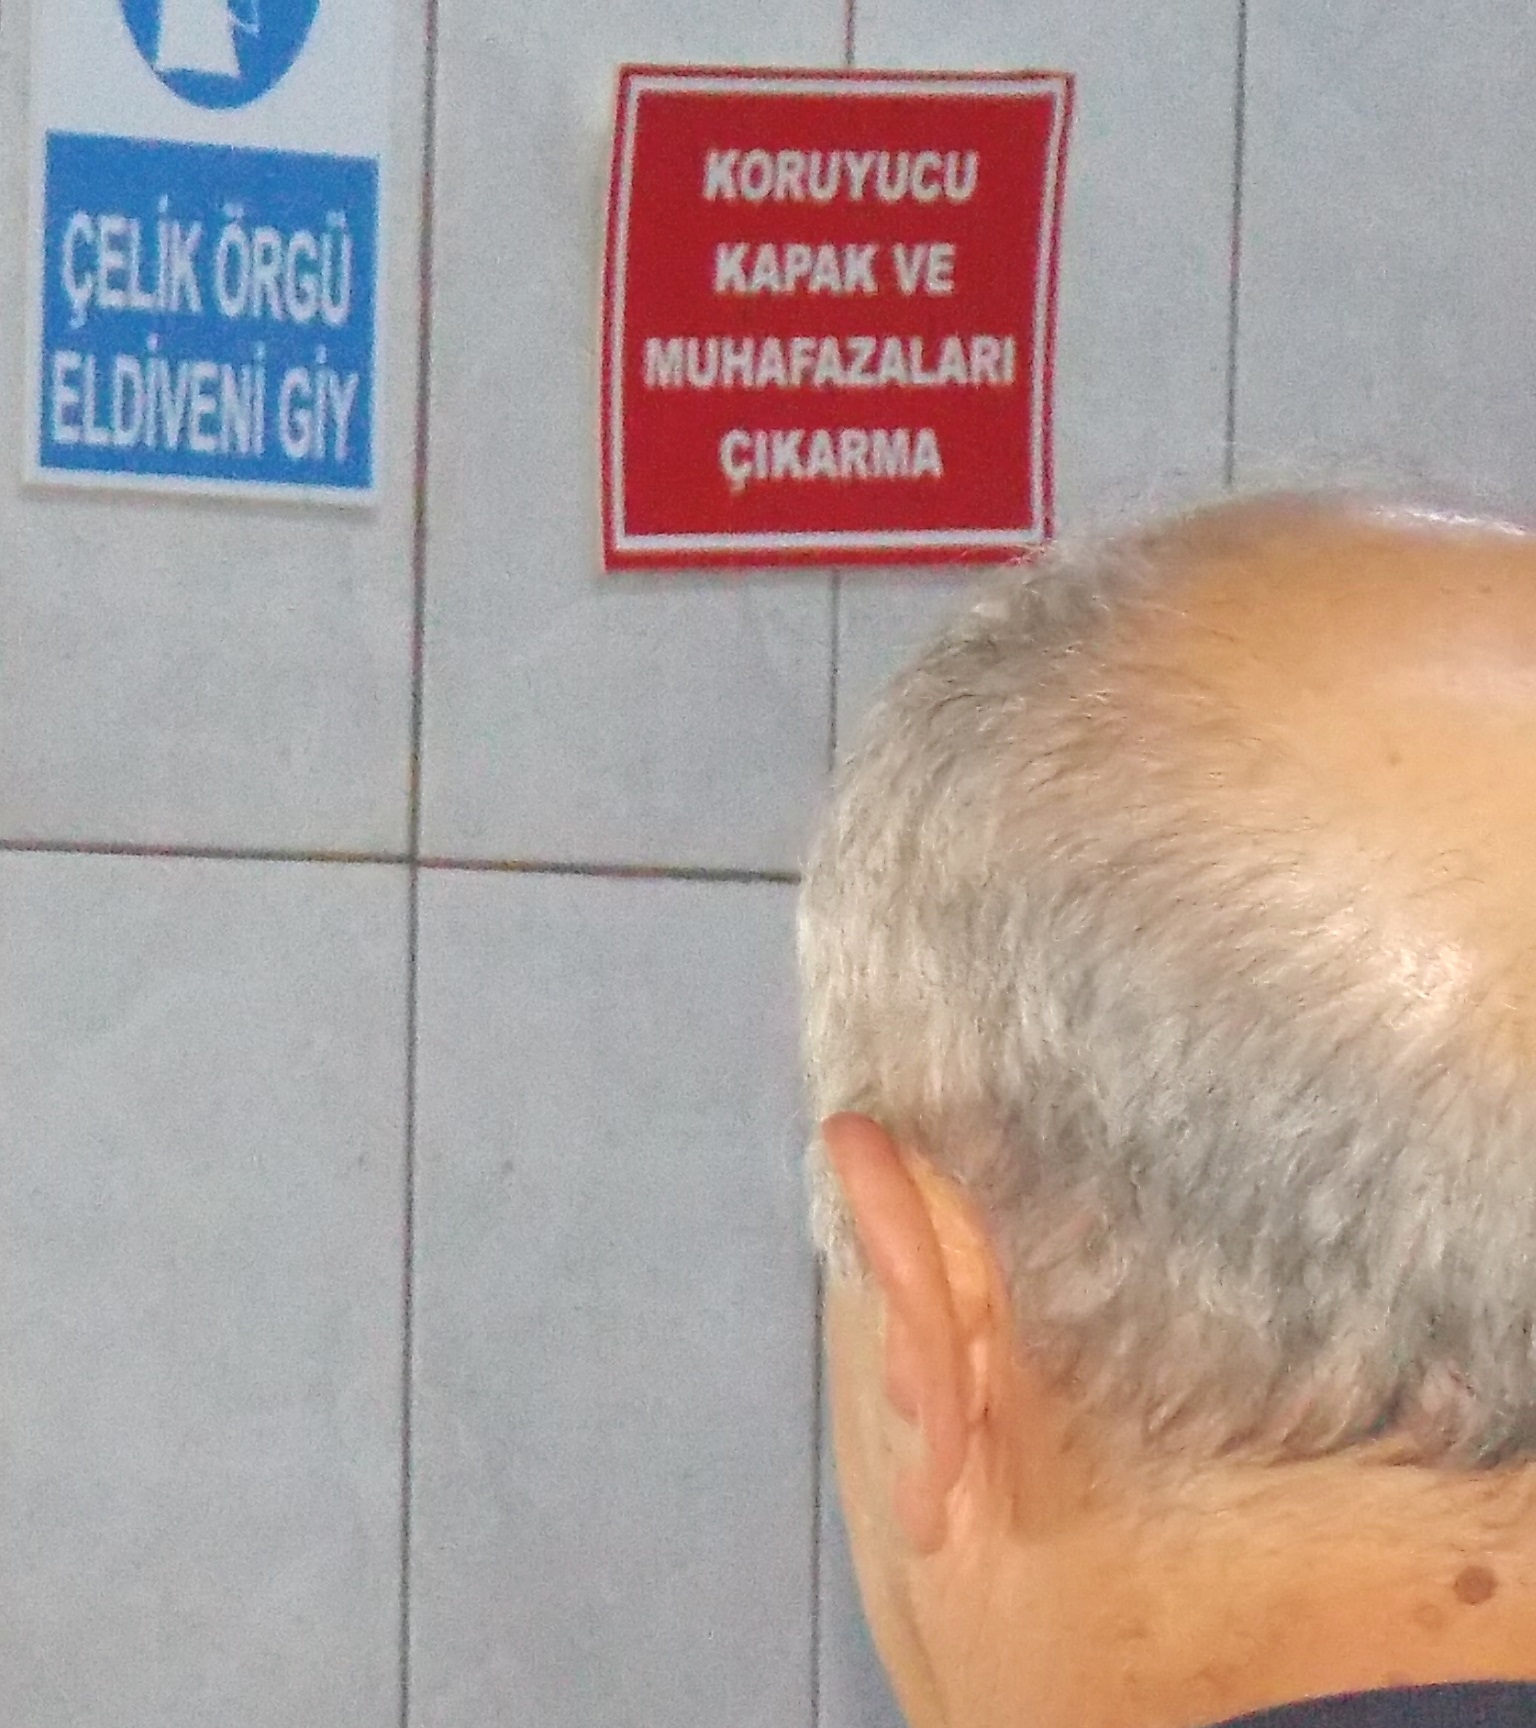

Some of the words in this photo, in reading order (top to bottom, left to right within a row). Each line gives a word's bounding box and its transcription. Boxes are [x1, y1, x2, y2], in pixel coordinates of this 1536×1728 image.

[704, 148, 980, 202] KORUYUCU
[61, 195, 203, 329] ÇELİK
[216, 203, 352, 327] ÖRGÜ
[713, 241, 880, 294] KAPAK
[893, 242, 957, 294] VE
[644, 335, 1017, 389] MUHAFAZALARI
[52, 333, 266, 457] ELDİVENİ
[279, 345, 360, 461] GİY
[719, 427, 945, 491] ÇIKARMA
